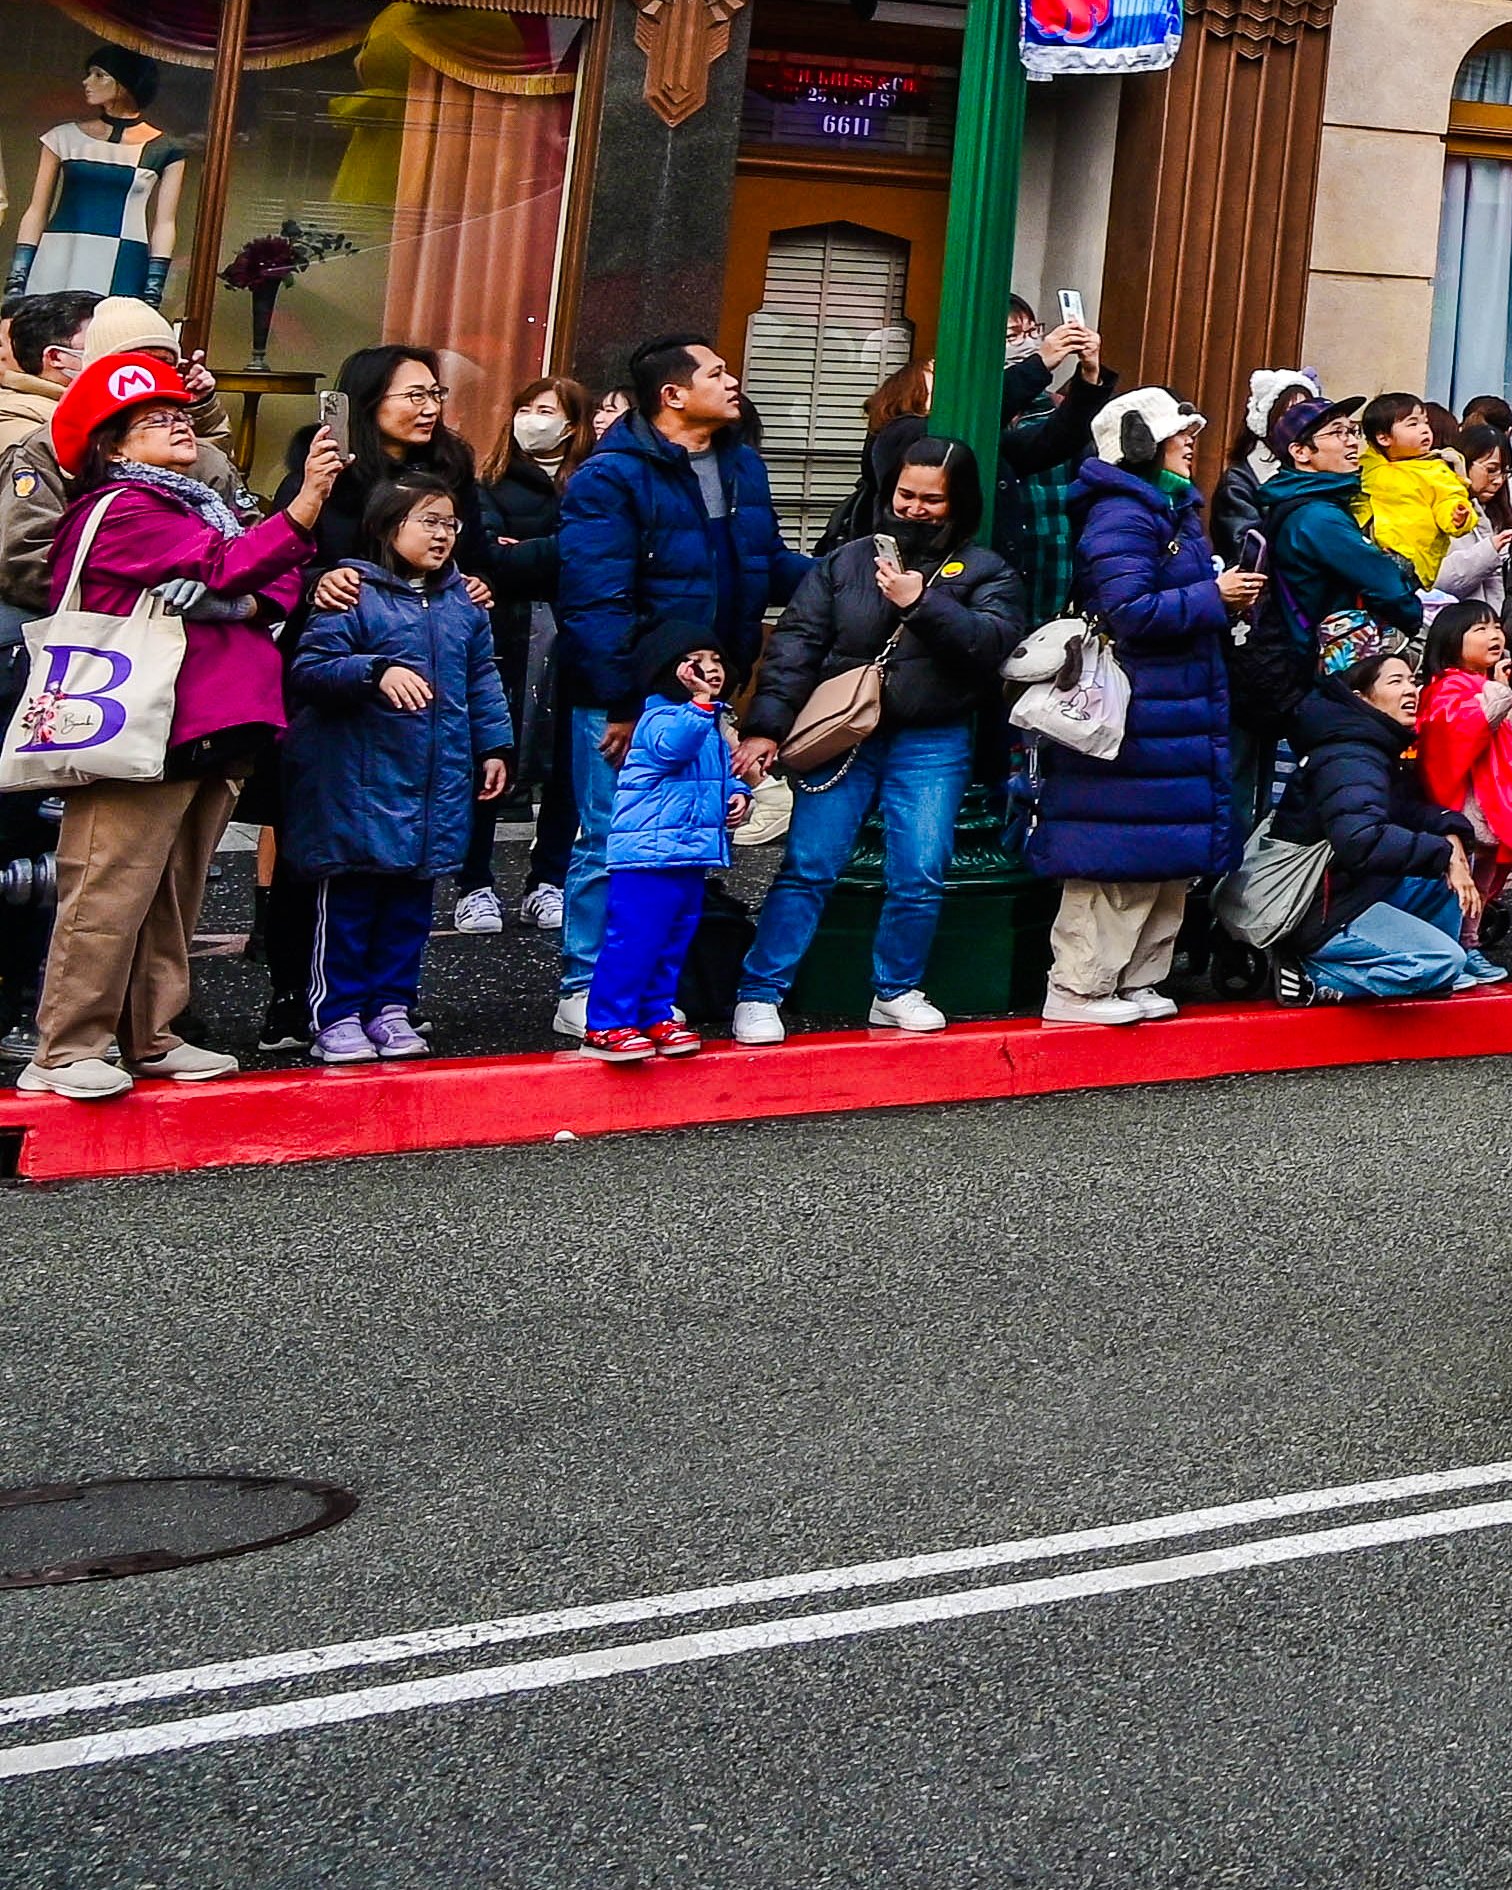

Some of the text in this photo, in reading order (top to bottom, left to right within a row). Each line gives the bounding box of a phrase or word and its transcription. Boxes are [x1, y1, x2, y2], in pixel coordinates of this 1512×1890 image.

[823, 114, 870, 136] 6611
[117, 370, 153, 396] M
[15, 645, 132, 753] B
